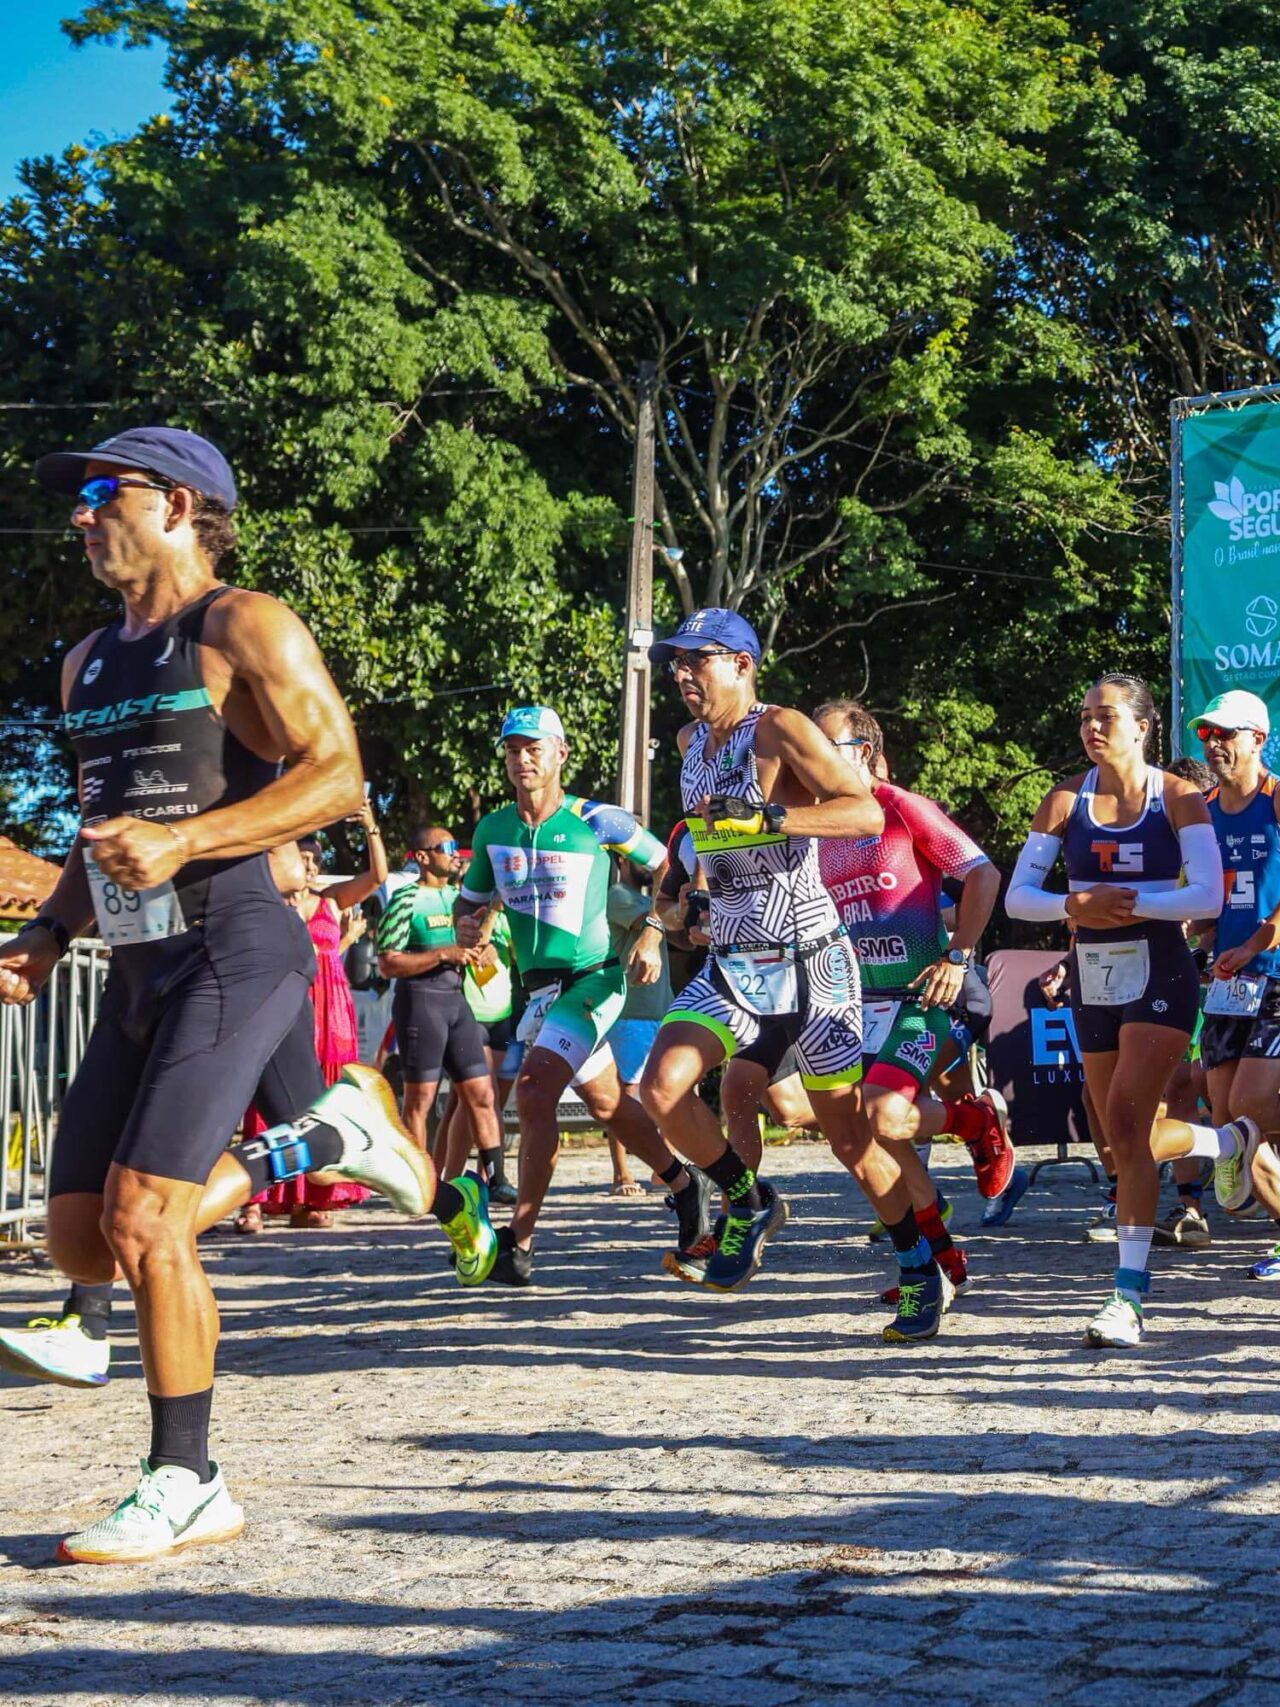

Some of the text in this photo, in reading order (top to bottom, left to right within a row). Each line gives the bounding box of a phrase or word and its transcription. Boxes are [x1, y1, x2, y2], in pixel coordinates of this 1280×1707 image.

[1228, 541, 1260, 565] Brasil
[143, 804, 185, 818] CARE
[186, 804, 198, 814] U
[732, 873, 769, 889] CUBA
[828, 872, 898, 903] IBEIRO
[103, 882, 141, 915] 89
[843, 899, 874, 927] BRA
[859, 936, 905, 958] SMG
[741, 974, 767, 996] 22
[1101, 965, 1114, 987] 7
[863, 1021, 878, 1039] 7
[901, 1041, 931, 1070] SMG
